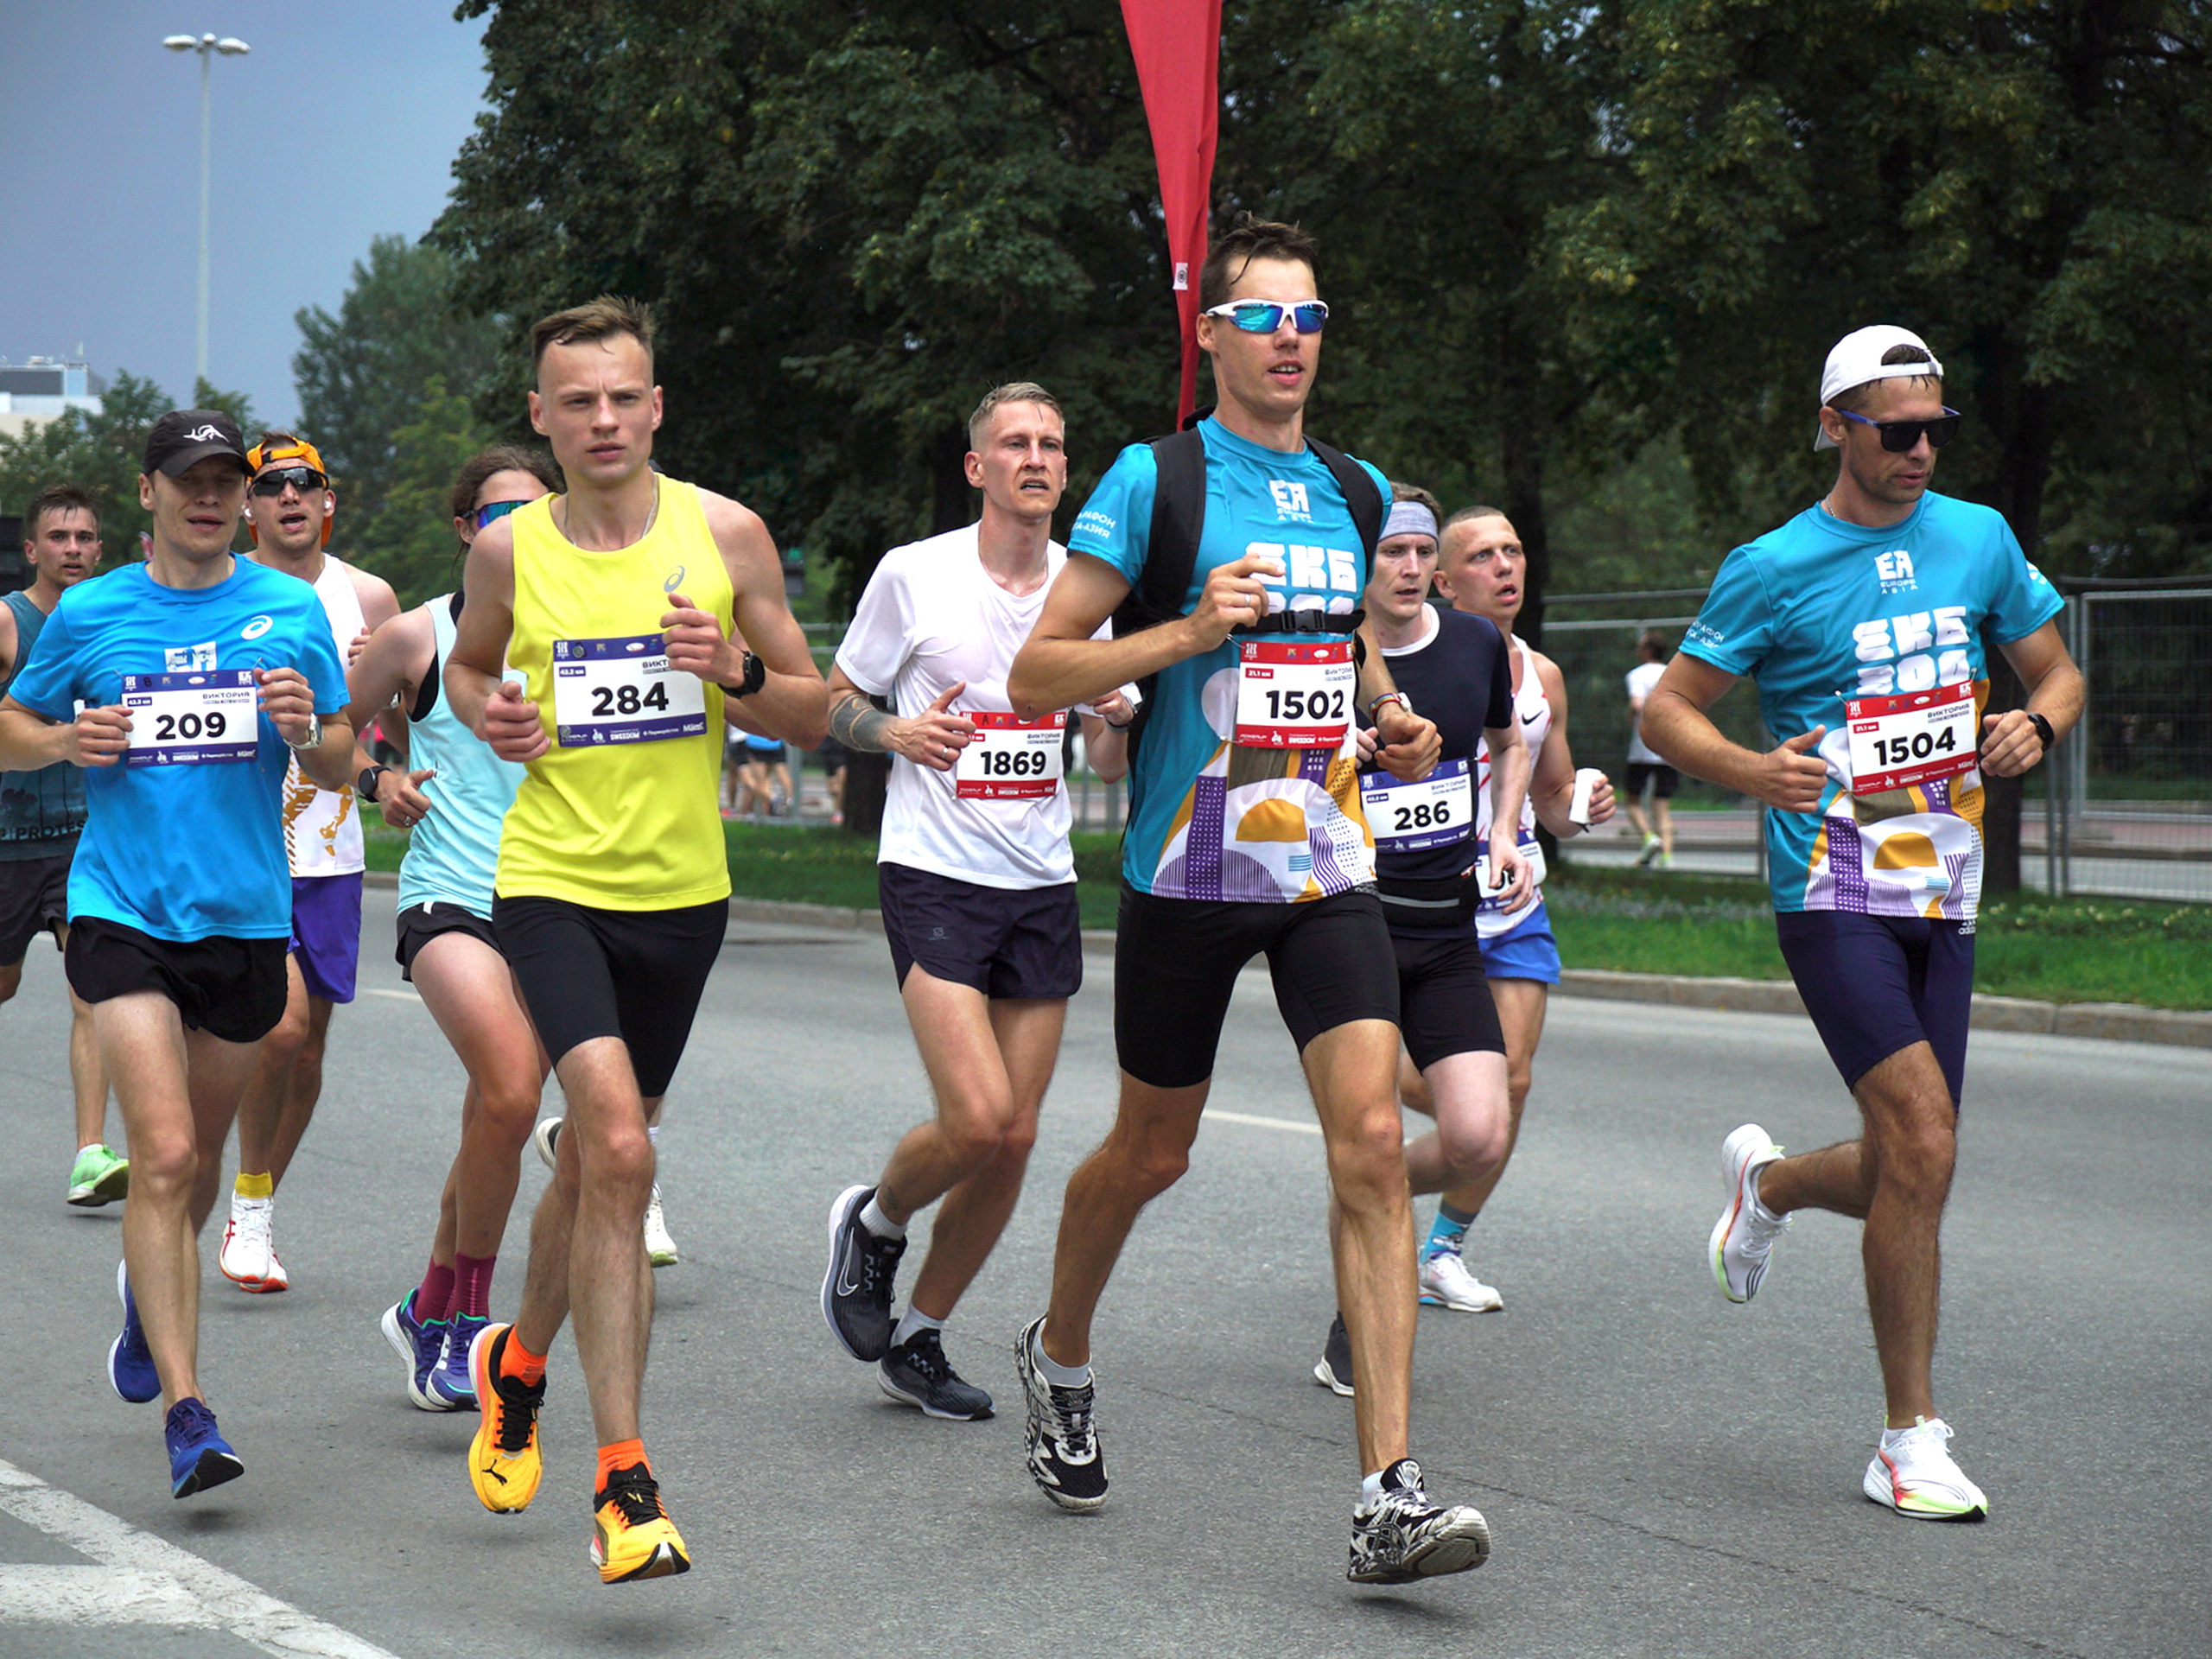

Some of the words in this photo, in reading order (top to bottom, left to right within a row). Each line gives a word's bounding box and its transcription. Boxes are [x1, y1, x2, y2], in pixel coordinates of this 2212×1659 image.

[642, 659, 669, 669] ВИКТ
[202, 691, 251, 700] ВИКТОРИЯ
[591, 681, 670, 717] 284
[1266, 690, 1344, 720] 1502
[1927, 702, 1970, 718] ВИКТОРИЯ
[156, 711, 226, 741] 209
[1873, 726, 1956, 766] 1504
[980, 750, 1046, 776] 1869
[1394, 801, 1450, 830] 286
